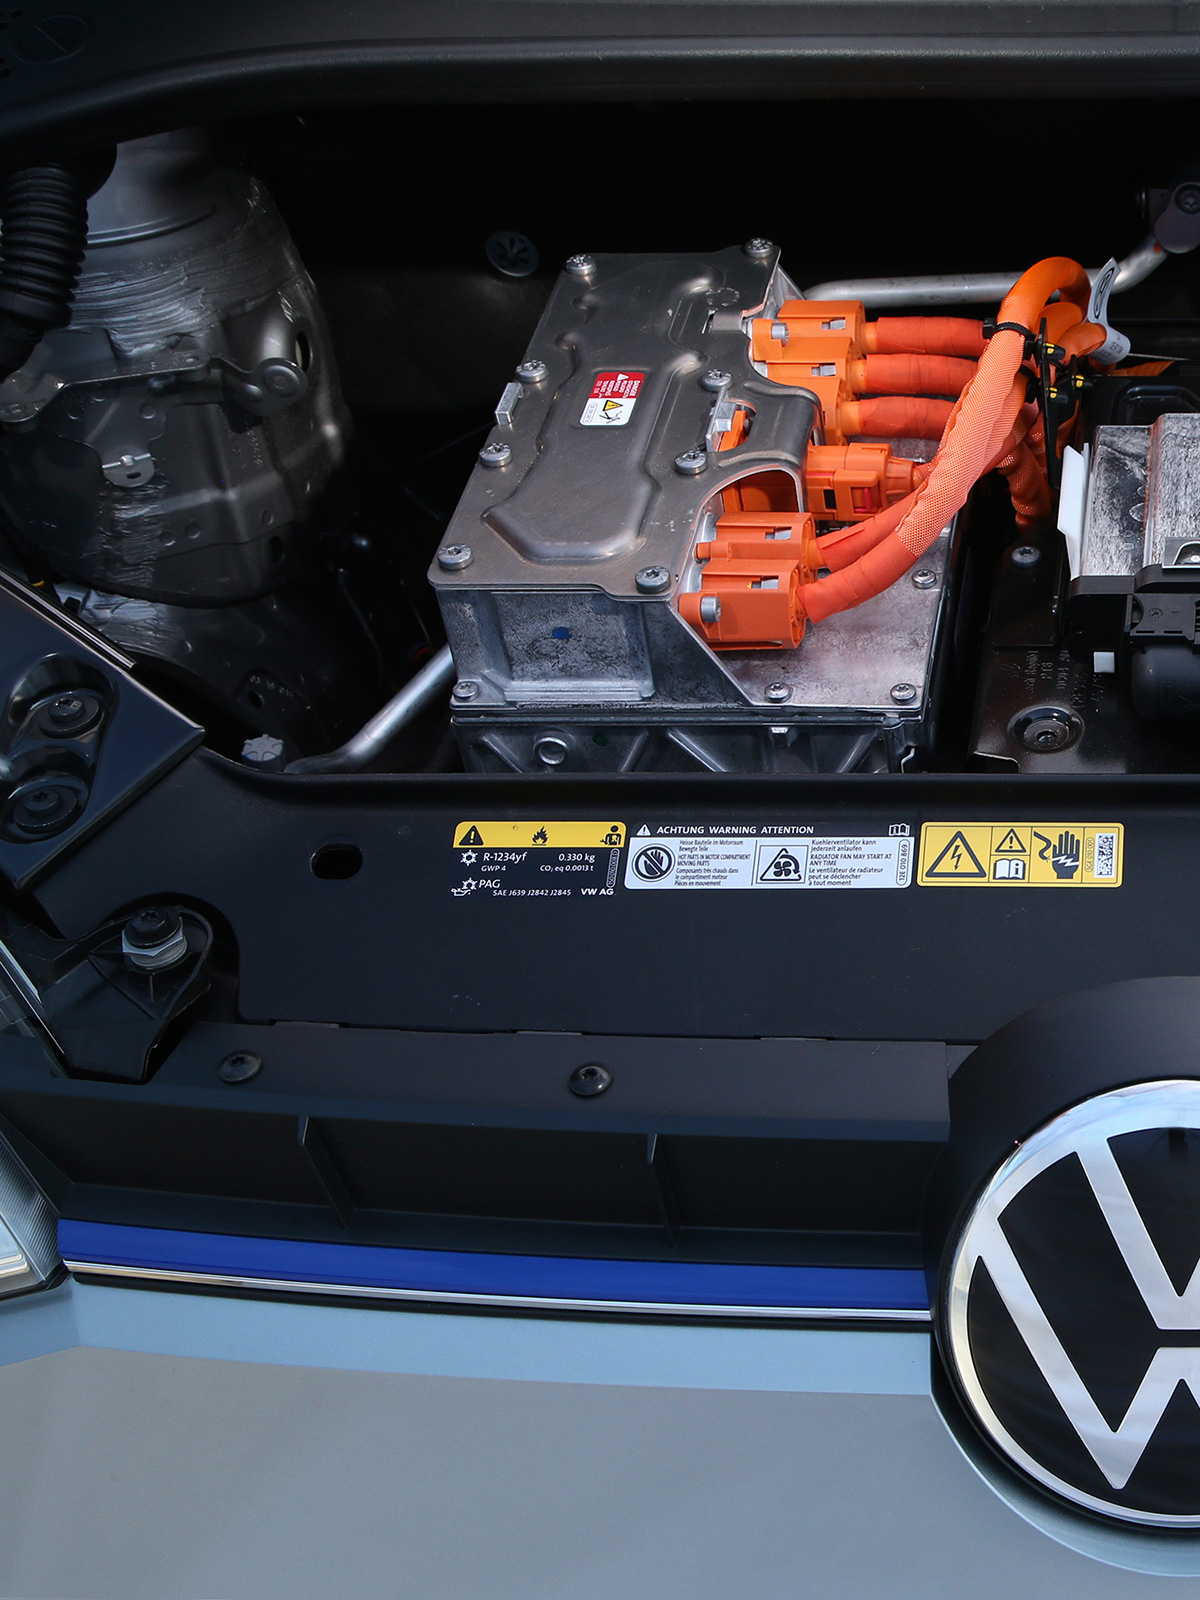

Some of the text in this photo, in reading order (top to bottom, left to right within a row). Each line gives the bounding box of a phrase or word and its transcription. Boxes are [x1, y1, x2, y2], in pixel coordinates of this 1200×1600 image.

[656, 826, 815, 834] ACHTUNG WARNING ATTENTION
[810, 845, 836, 853] jederzeit
[483, 851, 528, 864] R-1234yf
[558, 853, 596, 863] 0.330 kg
[808, 873, 822, 881] peut
[478, 879, 501, 889] PAG
[492, 889, 572, 897] SAE J639 J2842 J2845
[580, 888, 615, 896] VW AG
